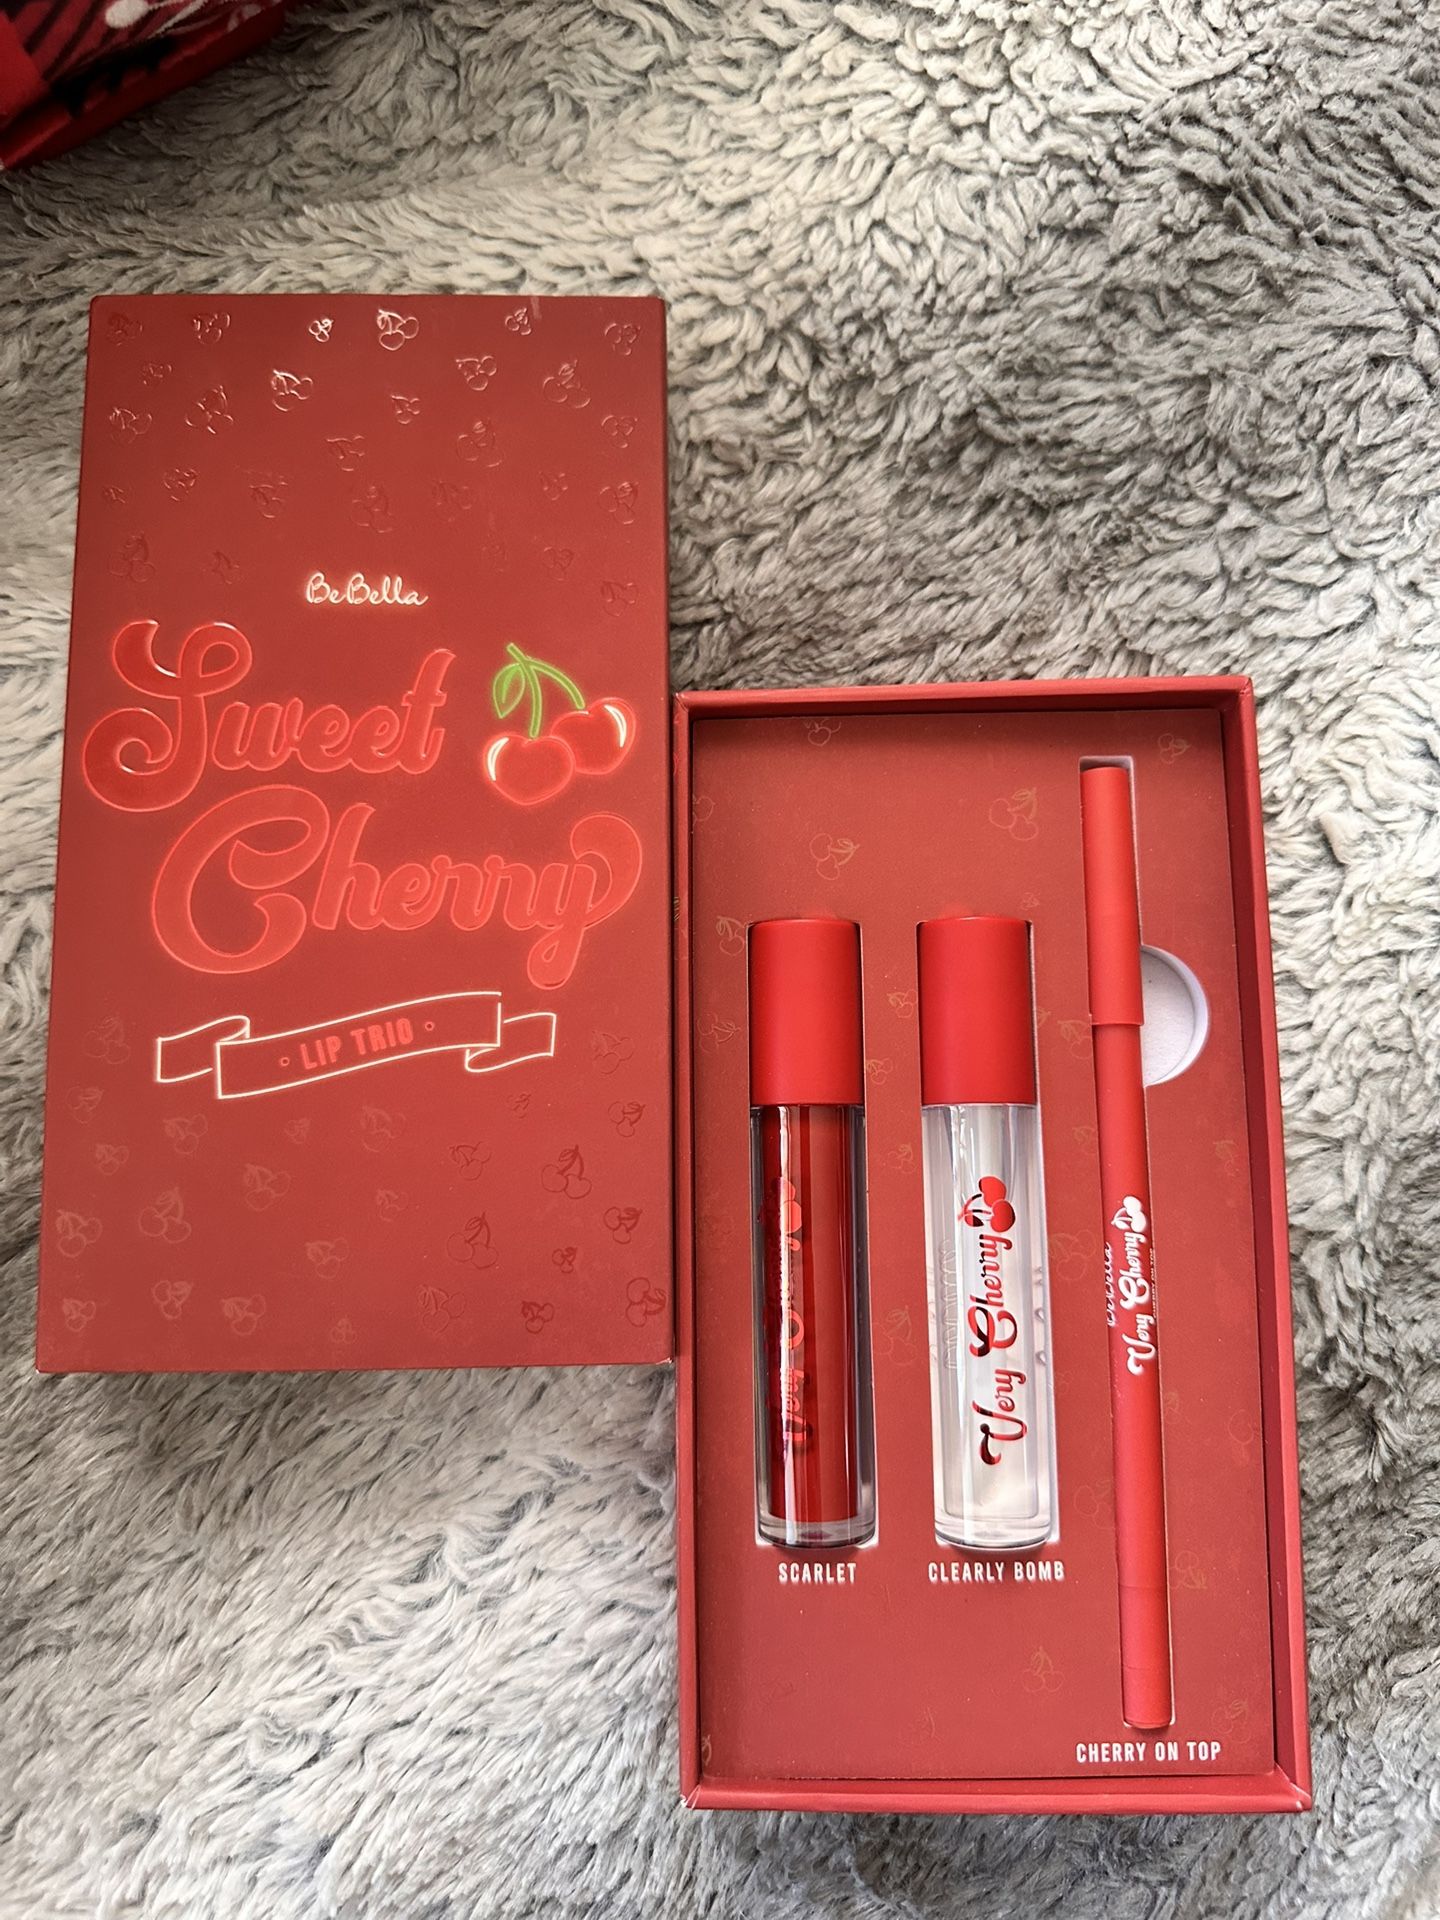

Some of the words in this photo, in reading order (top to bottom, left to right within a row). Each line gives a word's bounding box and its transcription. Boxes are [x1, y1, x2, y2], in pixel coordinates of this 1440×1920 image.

[305, 572, 429, 608] BeBella
[82, 619, 457, 812] Sweet
[151, 784, 643, 990] Cherry
[300, 1035, 342, 1070] LIP
[350, 1017, 414, 1056] TRIO
[967, 1233, 1018, 1358] Cherry
[1118, 1231, 1151, 1311] Cherry
[1121, 1313, 1156, 1376] Very
[972, 1368, 1028, 1466] Very
[778, 1562, 857, 1584] SCARLET
[928, 1561, 1005, 1584] CLEARLY
[1014, 1560, 1066, 1582] BOMB
[1076, 1743, 1146, 1763] CHERRY
[1155, 1742, 1179, 1761] ON
[1187, 1741, 1222, 1761] TOP
